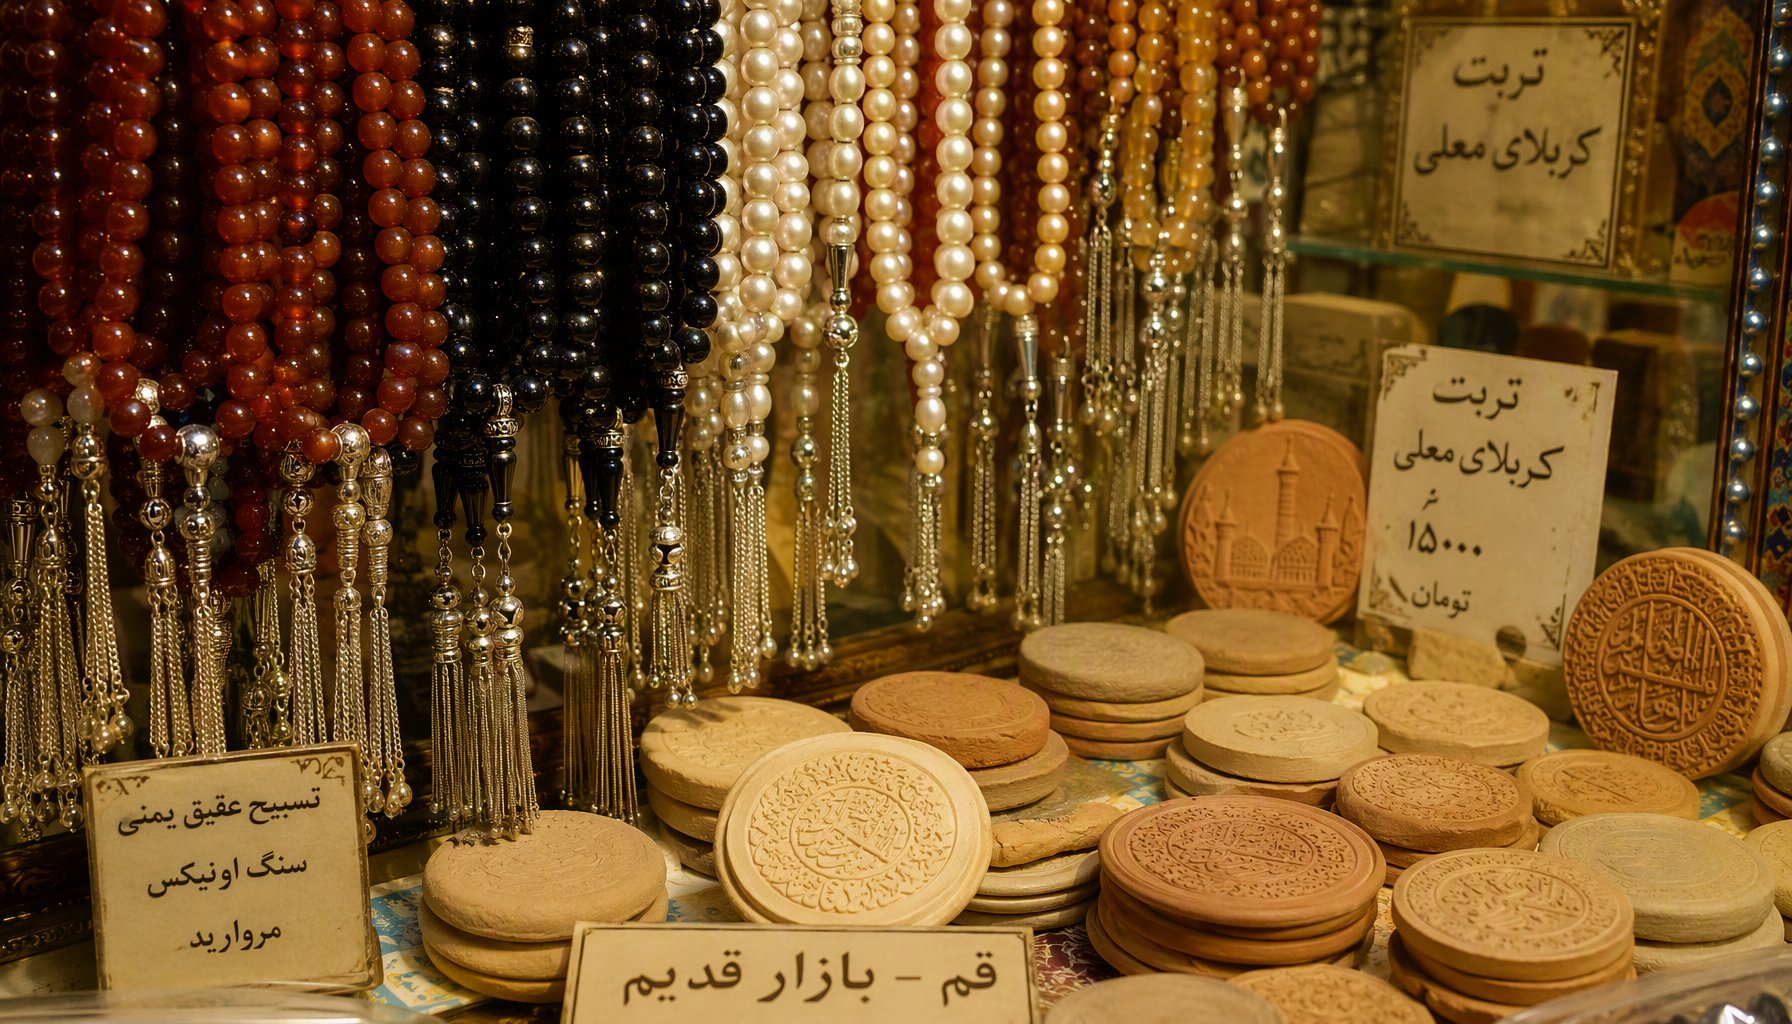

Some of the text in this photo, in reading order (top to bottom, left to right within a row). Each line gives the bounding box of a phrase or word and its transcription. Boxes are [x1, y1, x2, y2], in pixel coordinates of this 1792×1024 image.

[1452, 47, 1549, 100] تربت
[1414, 123, 1603, 179] کربلای معلی
[1432, 377, 1523, 420] تربت
[1394, 428, 1565, 488] کربلای معلی
[1407, 520, 1483, 557] ۱۵۰۰۰
[1411, 581, 1472, 619] تومان
[118, 787, 321, 837] تسبیح عقیق یمنی
[147, 851, 307, 898] سنگ اونیکس
[189, 919, 282, 953] مروارید
[622, 949, 743, 1006] قدیم
[756, 951, 875, 1004] بازار
[941, 950, 998, 1007] قم
